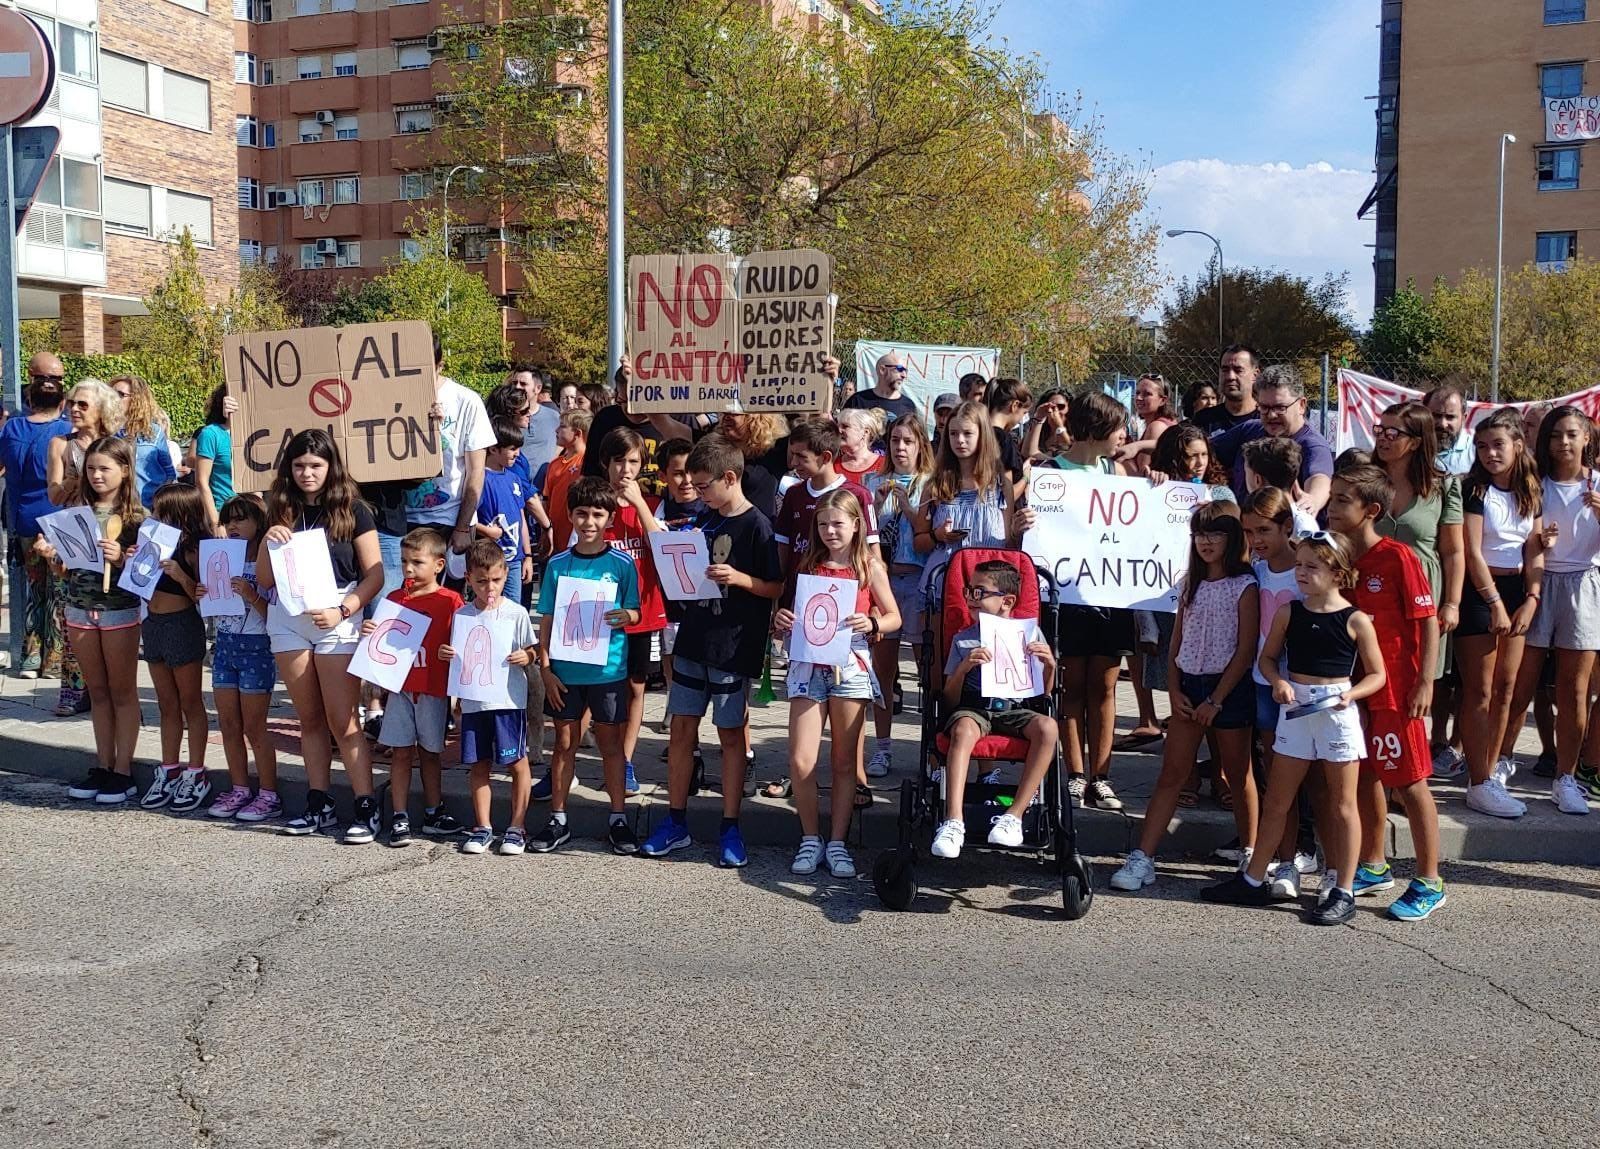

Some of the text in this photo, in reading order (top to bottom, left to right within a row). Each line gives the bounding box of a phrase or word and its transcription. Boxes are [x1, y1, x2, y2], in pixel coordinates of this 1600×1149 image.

[1553, 123, 1568, 136] DE
[637, 264, 724, 331] NO
[745, 264, 819, 294] RUIDO
[743, 300, 824, 325] BASURA
[669, 332, 696, 347] AL
[742, 326, 824, 349] OLORES
[239, 332, 422, 392] NO AL
[635, 340, 746, 385] CANTÓN
[744, 351, 828, 375] PLAGAS
[752, 377, 807, 388] LIMPIO
[670, 385, 690, 400] UN
[244, 403, 437, 472] CATÓN
[1039, 482, 1064, 490] STOP
[1088, 489, 1139, 526] NO
[1171, 495, 1197, 503] STOP
[49, 514, 98, 562] N
[1100, 532, 1120, 544] AL
[130, 541, 162, 587] O
[206, 550, 234, 601] A
[661, 543, 697, 594] T
[1054, 544, 1173, 589] CANTÓN
[563, 590, 606, 651] N
[803, 583, 839, 646] Ó
[368, 618, 411, 665] C
[460, 625, 494, 687] A
[994, 629, 1034, 691] N
[1372, 732, 1402, 761] 29
